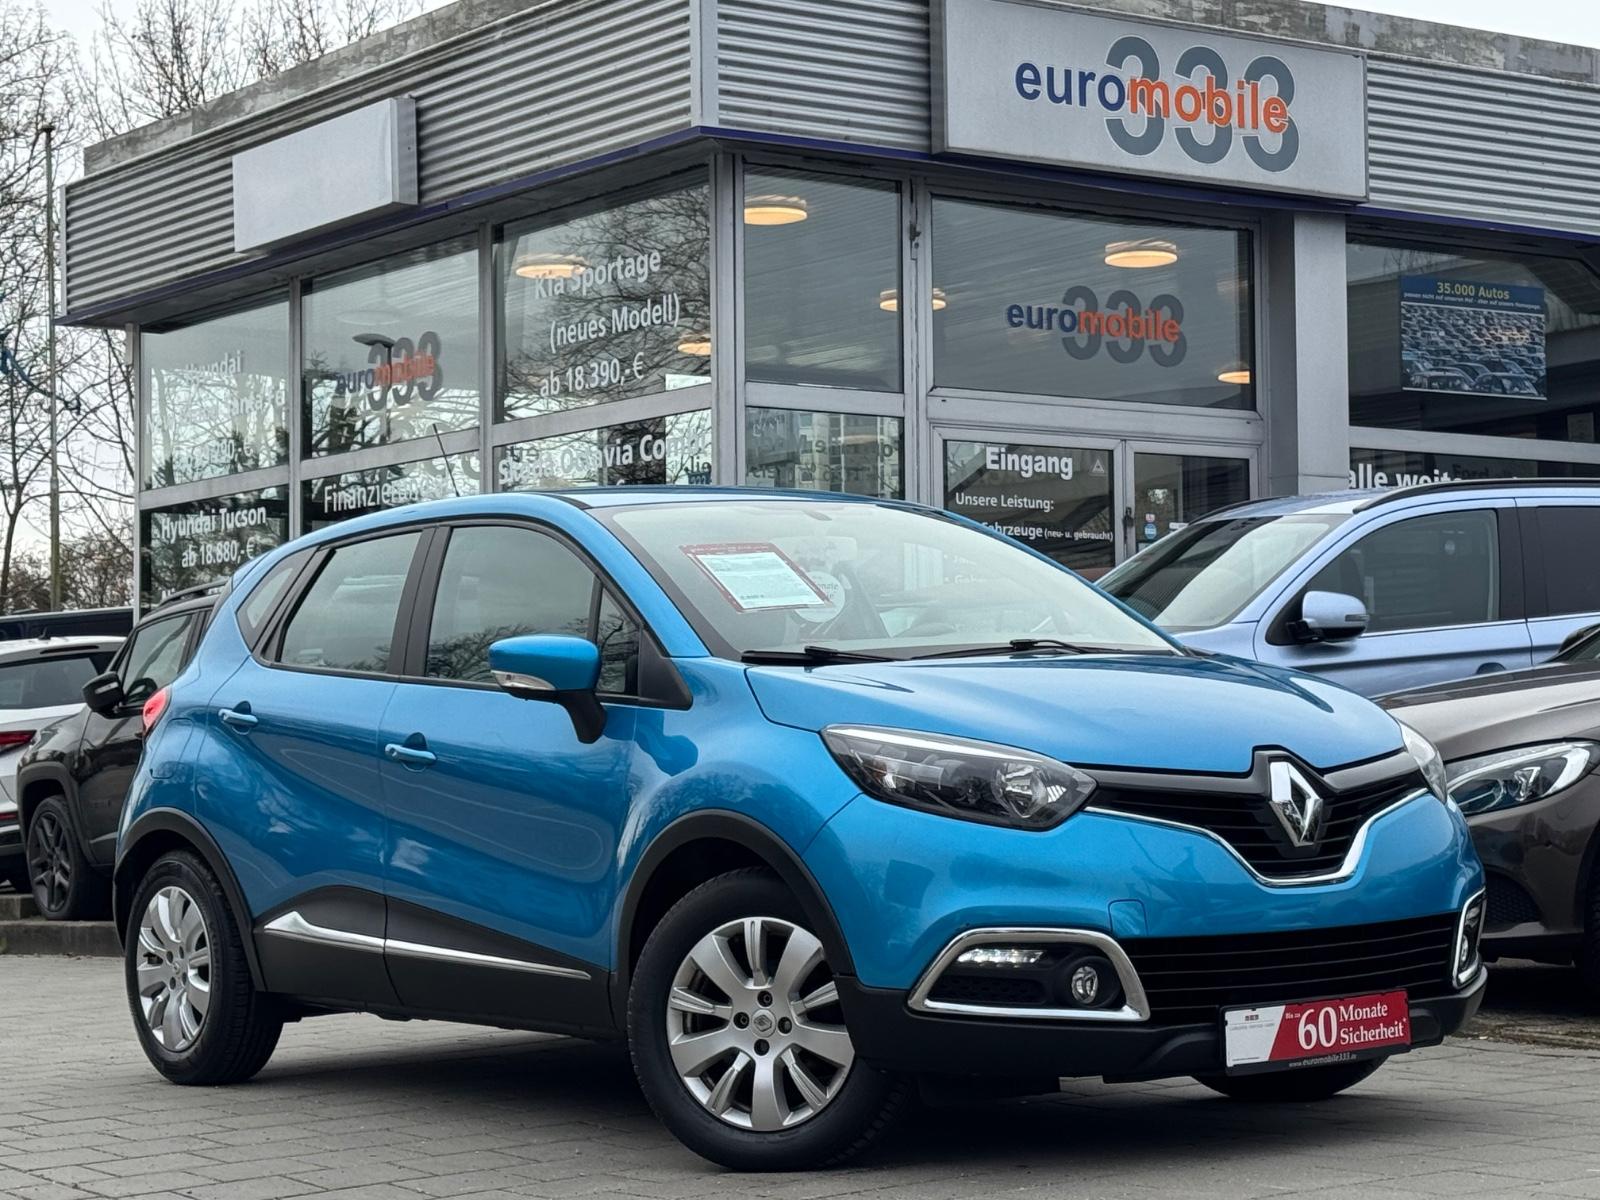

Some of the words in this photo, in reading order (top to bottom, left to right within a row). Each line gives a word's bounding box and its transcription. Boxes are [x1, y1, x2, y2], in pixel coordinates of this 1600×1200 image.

[1015, 61, 1289, 134] euromobile
[1104, 35, 1300, 173] 333
[535, 272, 566, 299] Kia
[572, 251, 661, 295] Sportage
[1436, 281, 1475, 297] 35.000
[1478, 286, 1510, 300] Autos
[549, 320, 607, 354] (neues
[610, 293, 680, 332] Modell)
[1006, 304, 1182, 342] euromobile
[1062, 285, 1187, 368] 333
[369, 331, 443, 411] 333
[541, 370, 561, 397] ab
[985, 446, 1073, 480] Eingang
[955, 492, 998, 506] Unsere
[1001, 494, 1055, 512] Leistung:
[162, 509, 216, 544] Hyundai
[219, 507, 267, 530] Tucson
[1044, 528, 1064, 539] (neu-
[1074, 530, 1114, 543] gebraucht)
[181, 543, 198, 568] ab
[1298, 1006, 1338, 1051] 60
[1339, 1001, 1388, 1022] Monate
